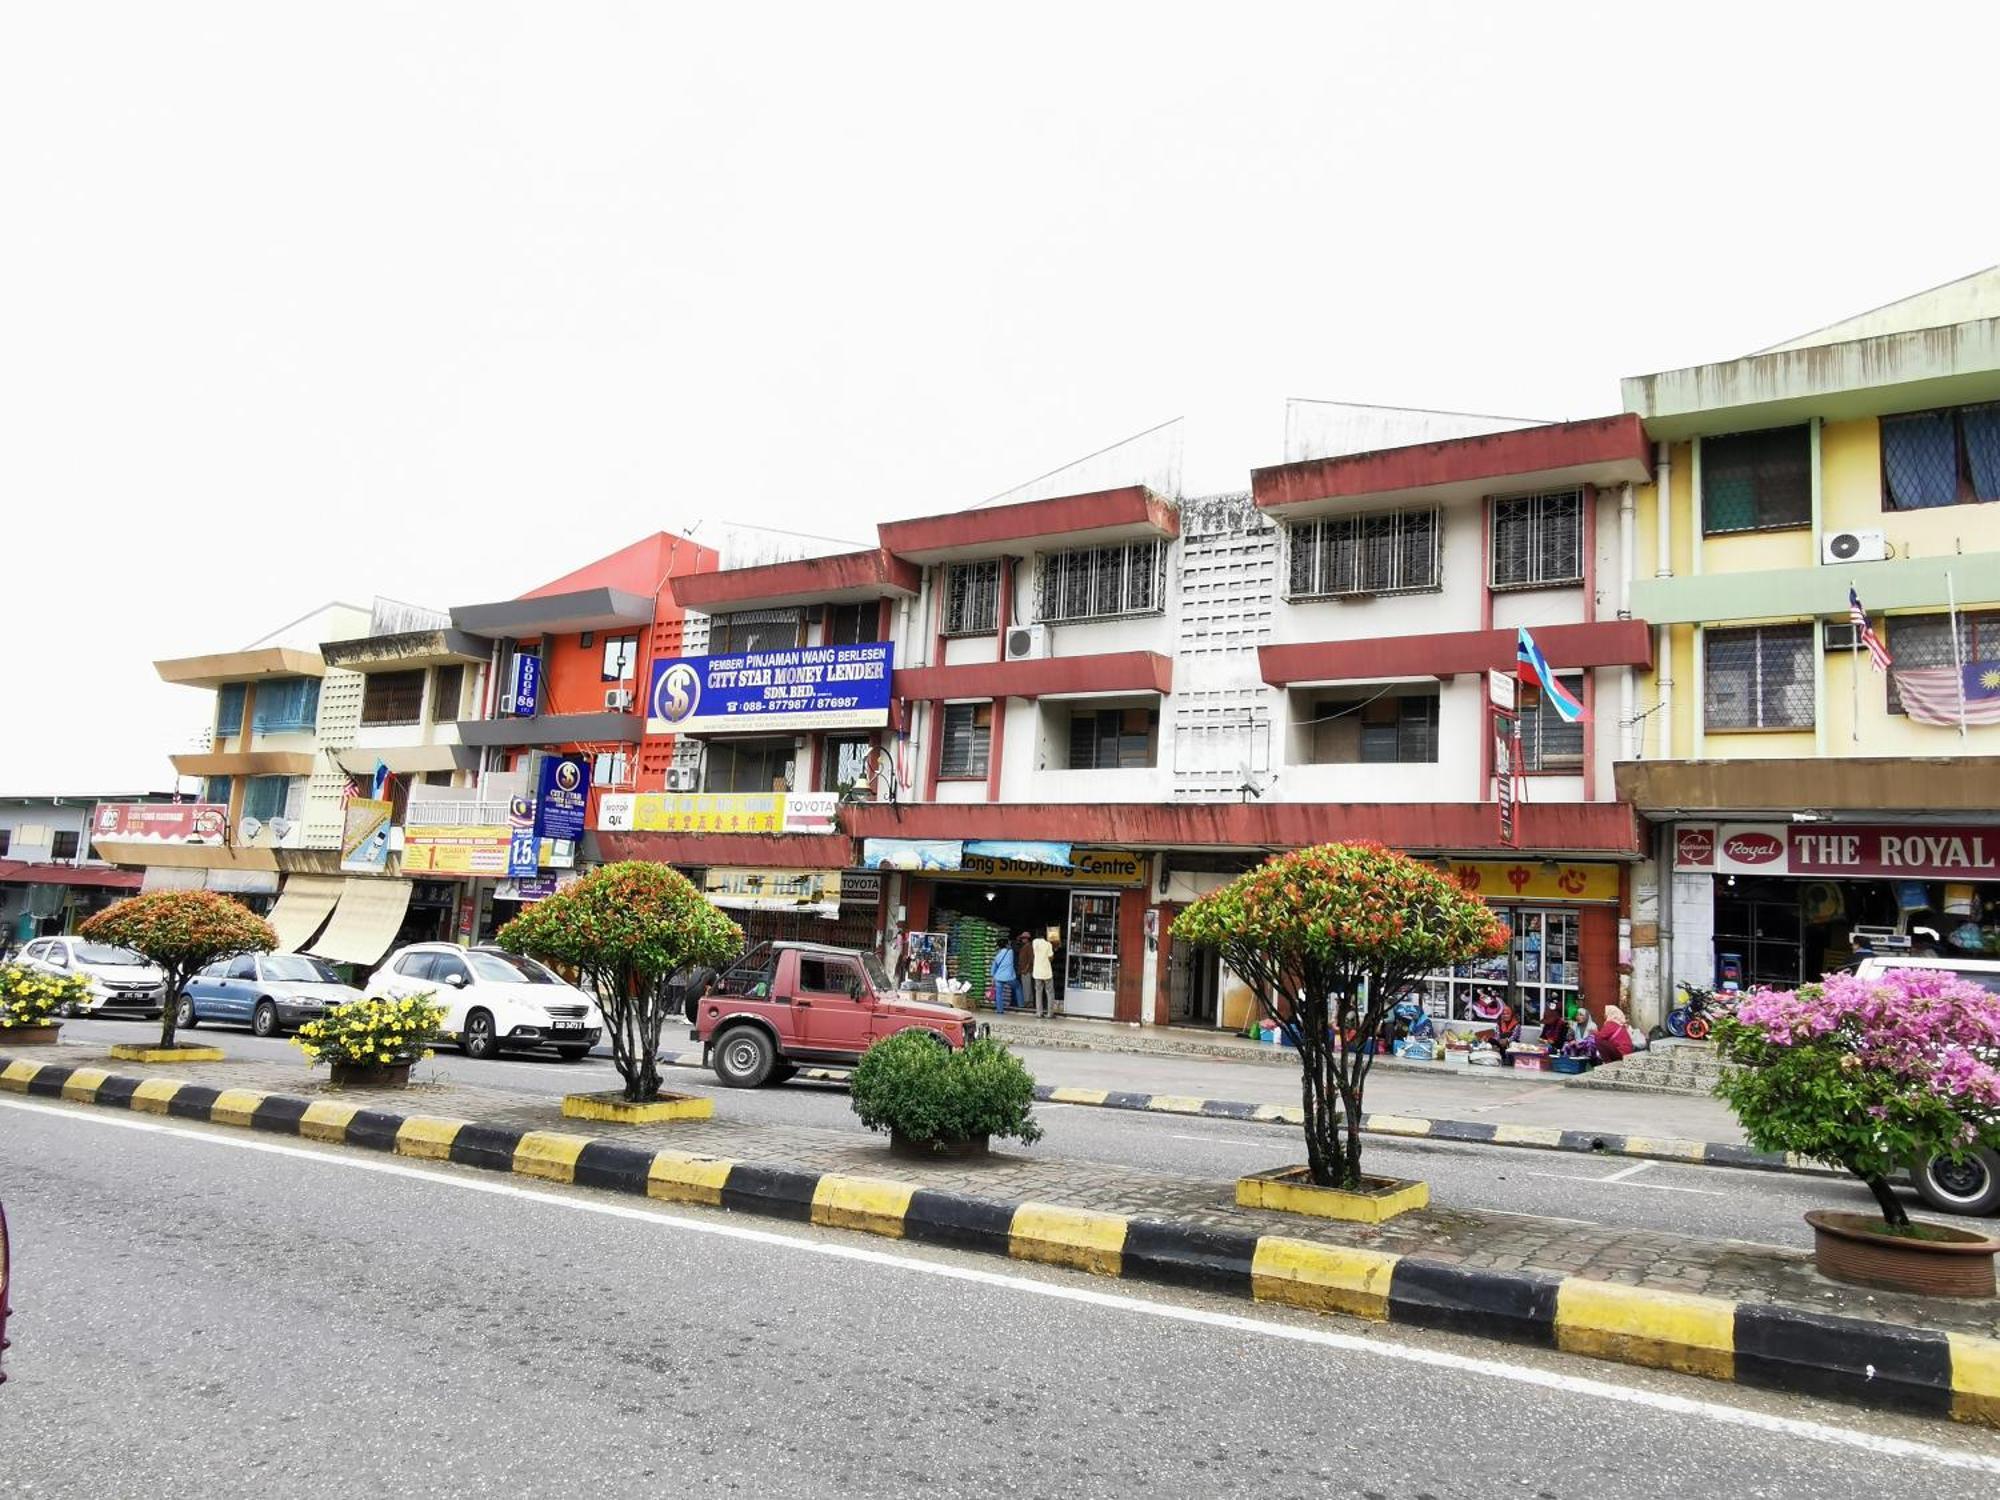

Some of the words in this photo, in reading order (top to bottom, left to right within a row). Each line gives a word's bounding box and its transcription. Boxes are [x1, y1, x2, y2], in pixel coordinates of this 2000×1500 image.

[708, 658, 743, 671] PEMBERI
[746, 651, 800, 668] PINJAMAN
[801, 649, 835, 664] WANG
[838, 648, 886, 662] BERLESEN
[523, 657, 533, 696] LODGE
[707, 671, 738, 689] CITY
[738, 669, 771, 687] STAR
[773, 665, 827, 685] MONEY
[827, 662, 884, 681] LENDER
[517, 696, 534, 707] 88
[764, 687, 788, 699] SDN.
[789, 685, 816, 698] BHD.
[769, 699, 807, 710] 877987
[817, 697, 858, 709] 876987
[789, 801, 832, 812] TOYOTA
[1729, 841, 1776, 861] Royal
[1795, 835, 1860, 864] THE
[1880, 836, 1995, 867] ROYAL
[1080, 855, 1136, 875] Centre
[842, 879, 878, 889] TOYOTA
